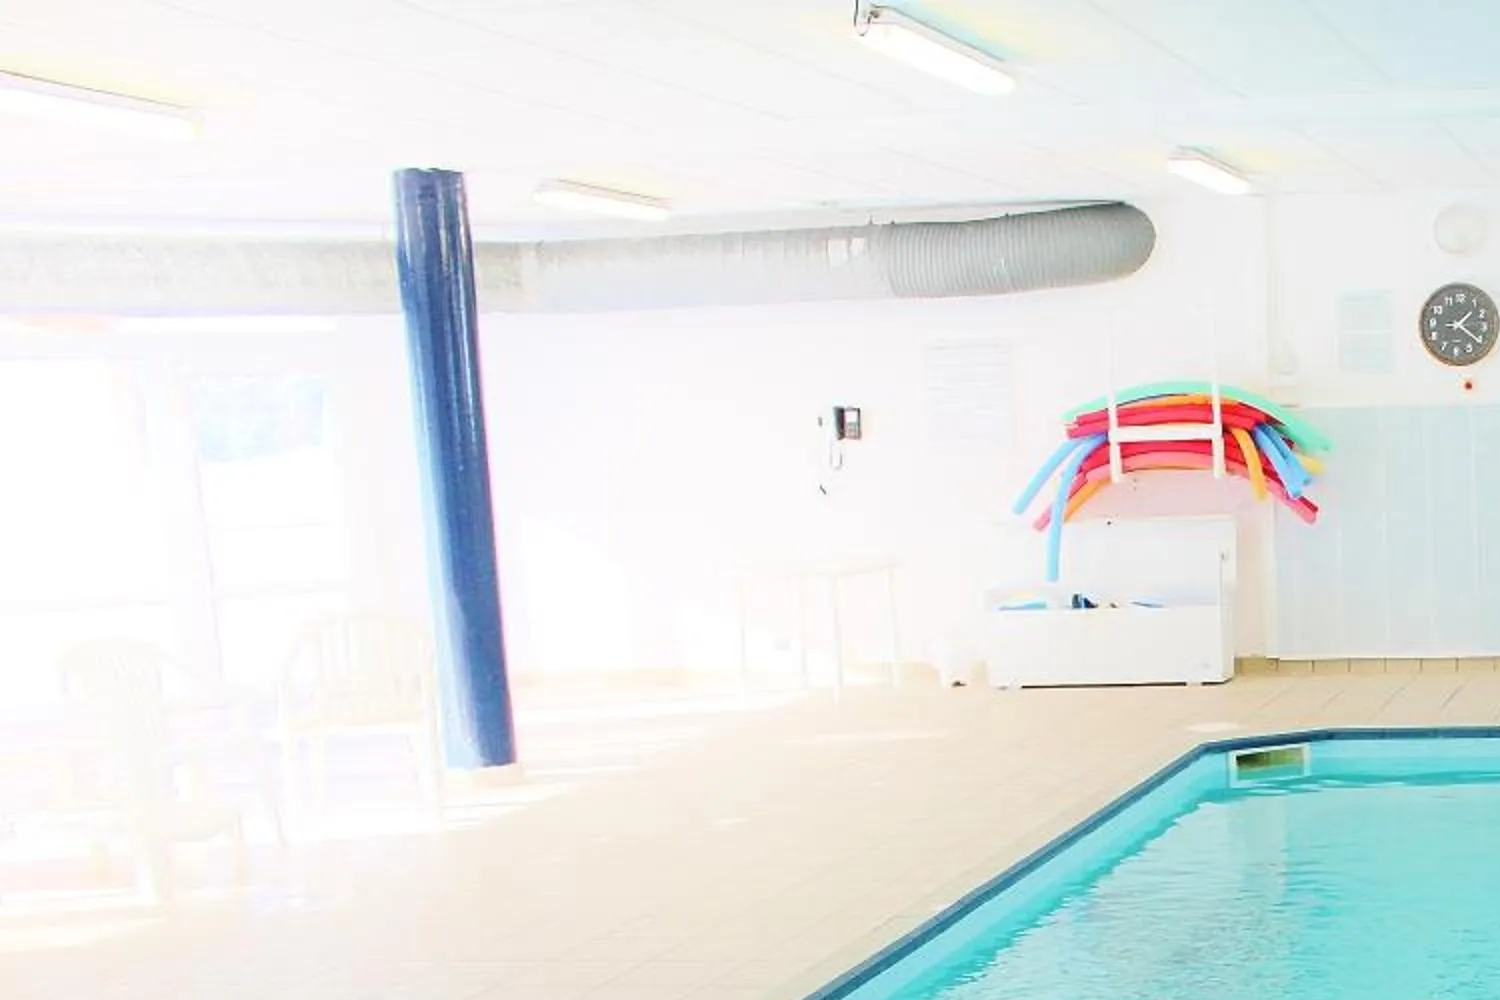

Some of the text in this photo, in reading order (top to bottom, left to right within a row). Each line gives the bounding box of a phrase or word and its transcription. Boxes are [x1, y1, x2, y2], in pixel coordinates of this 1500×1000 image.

[1444, 296, 1453, 306] 11
[1431, 305, 1443, 315] 10
[1479, 308, 1486, 318] 2
[1429, 318, 1437, 329] 9
[1441, 341, 1449, 351] 7
